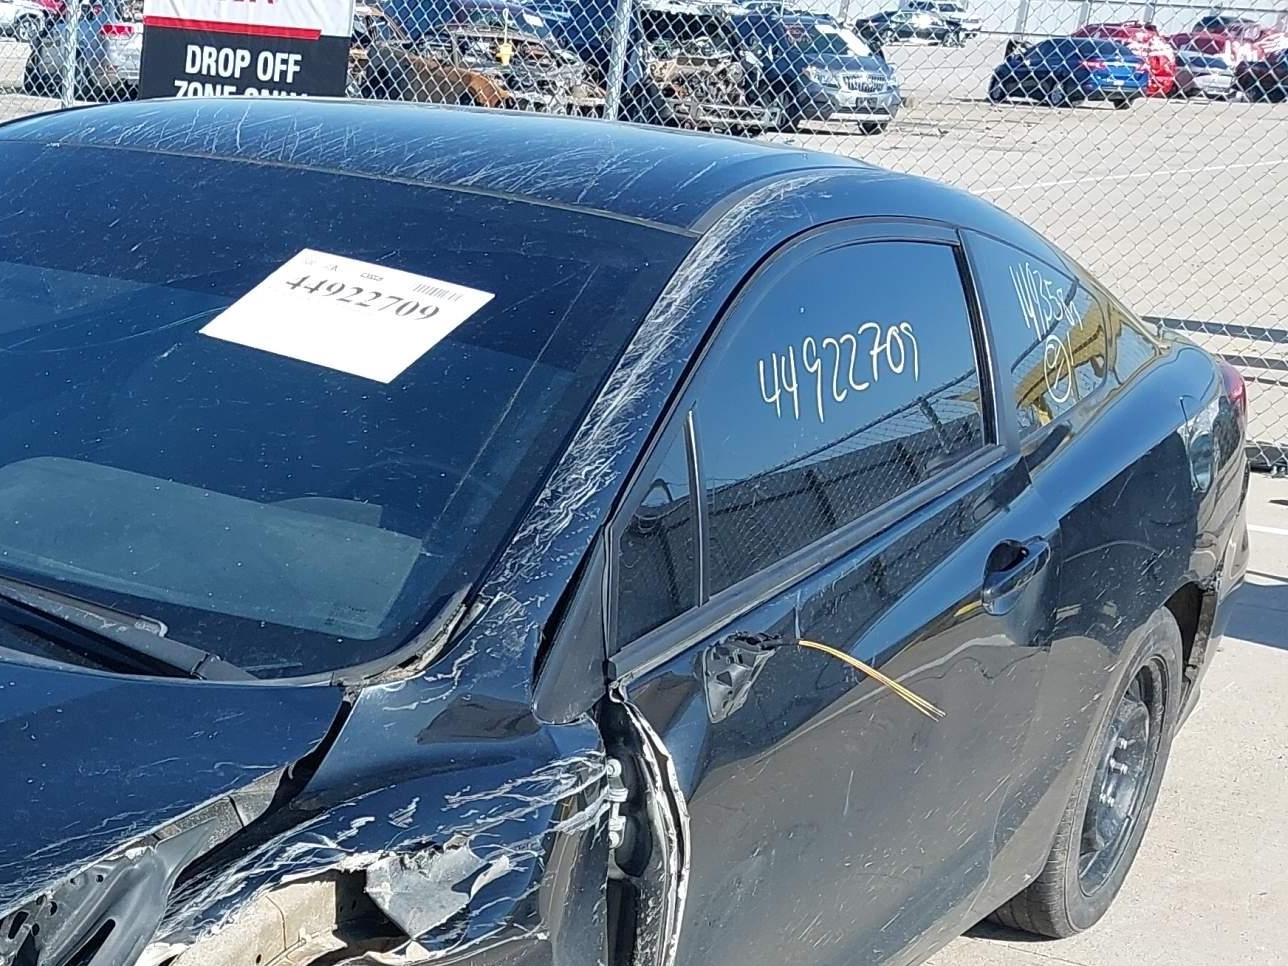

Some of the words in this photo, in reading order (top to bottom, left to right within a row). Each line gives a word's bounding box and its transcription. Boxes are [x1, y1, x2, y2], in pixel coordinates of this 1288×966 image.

[185, 44, 251, 78] DROP
[256, 50, 302, 83] OFF
[285, 275, 439, 320] 44922709
[759, 322, 919, 423] 44922709
